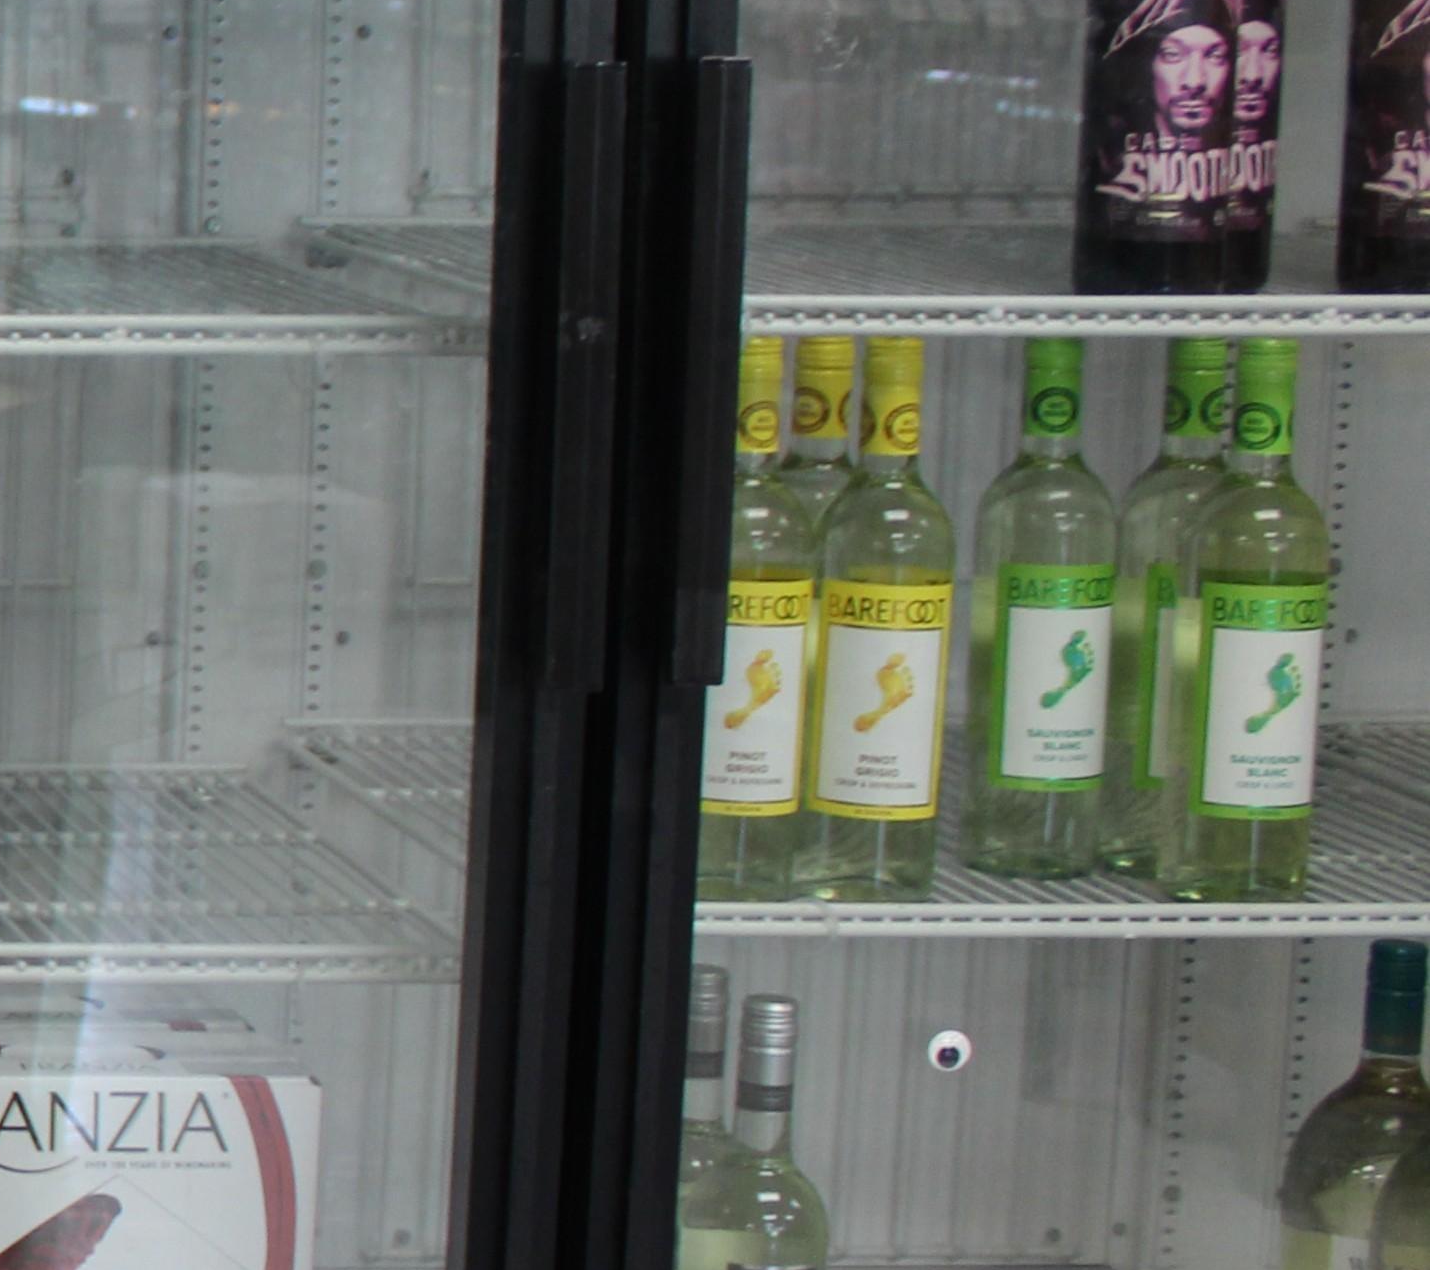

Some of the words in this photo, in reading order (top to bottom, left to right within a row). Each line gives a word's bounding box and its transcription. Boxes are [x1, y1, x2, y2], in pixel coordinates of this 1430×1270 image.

[1010, 576, 1110, 601] BAREFOO
[728, 593, 809, 620] REFOOT
[827, 593, 945, 625] BAREFOOT
[1028, 729, 1094, 738] SAUVIGNON
[1043, 742, 1082, 751] BLANC
[728, 752, 767, 761] PINOT
[859, 755, 898, 765] PINOT
[1230, 755, 1302, 765] SAUVIGNON
[725, 764, 769, 774] GRIGIO
[855, 767, 900, 778] GRIGIO
[1246, 768, 1287, 778] BLANC
